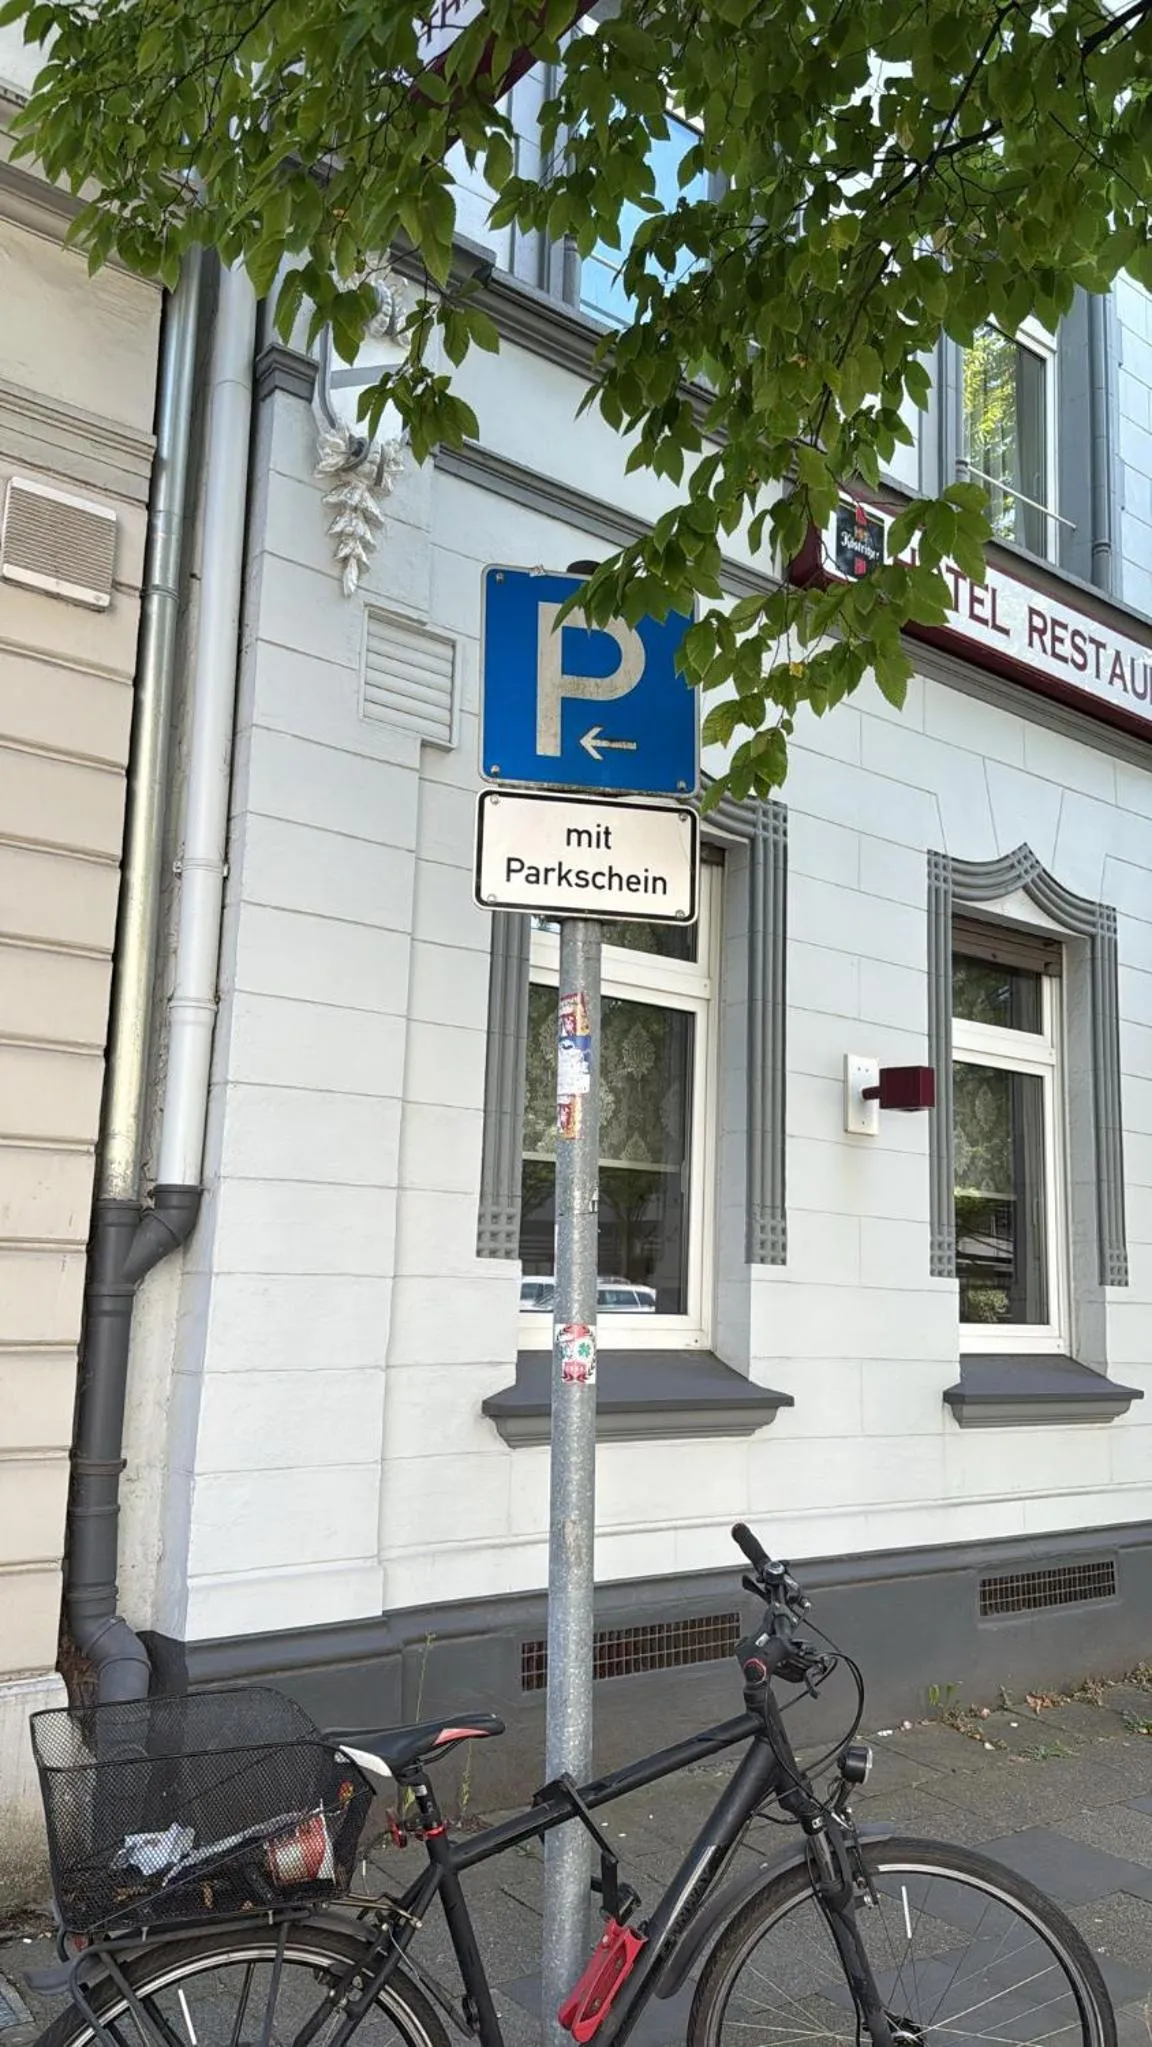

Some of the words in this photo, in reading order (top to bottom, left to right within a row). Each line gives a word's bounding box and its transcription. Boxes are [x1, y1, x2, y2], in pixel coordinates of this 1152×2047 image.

[911, 547, 1010, 638] TEL
[1028, 605, 1152, 706] RESTAU
[536, 601, 646, 757] P
[506, 857, 667, 895] Parkschein
[566, 824, 612, 849] mit
